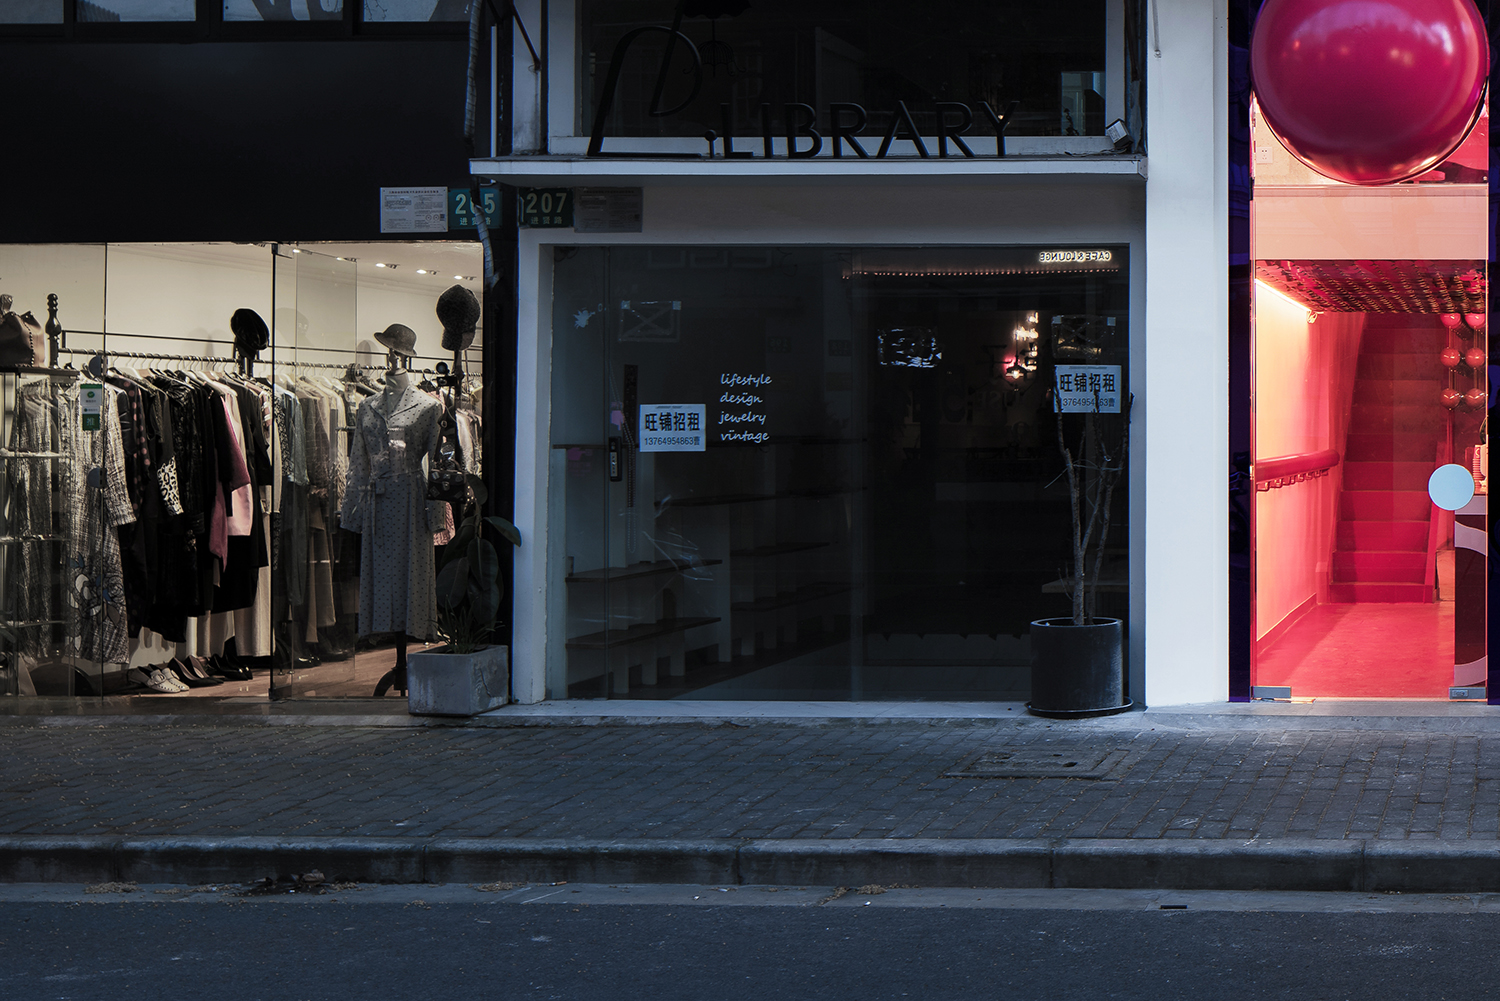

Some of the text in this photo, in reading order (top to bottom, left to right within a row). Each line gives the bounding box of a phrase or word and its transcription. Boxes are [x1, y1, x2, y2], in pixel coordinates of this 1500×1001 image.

[720, 100, 1020, 158] LIBRARY
[525, 192, 568, 214] 207
[530, 215, 563, 225] 进贤路
[720, 373, 773, 387] lifestyle
[1059, 372, 1116, 393] 旺铺招租
[644, 411, 700, 432] 旺铺招租
[718, 410, 767, 426] jewelry
